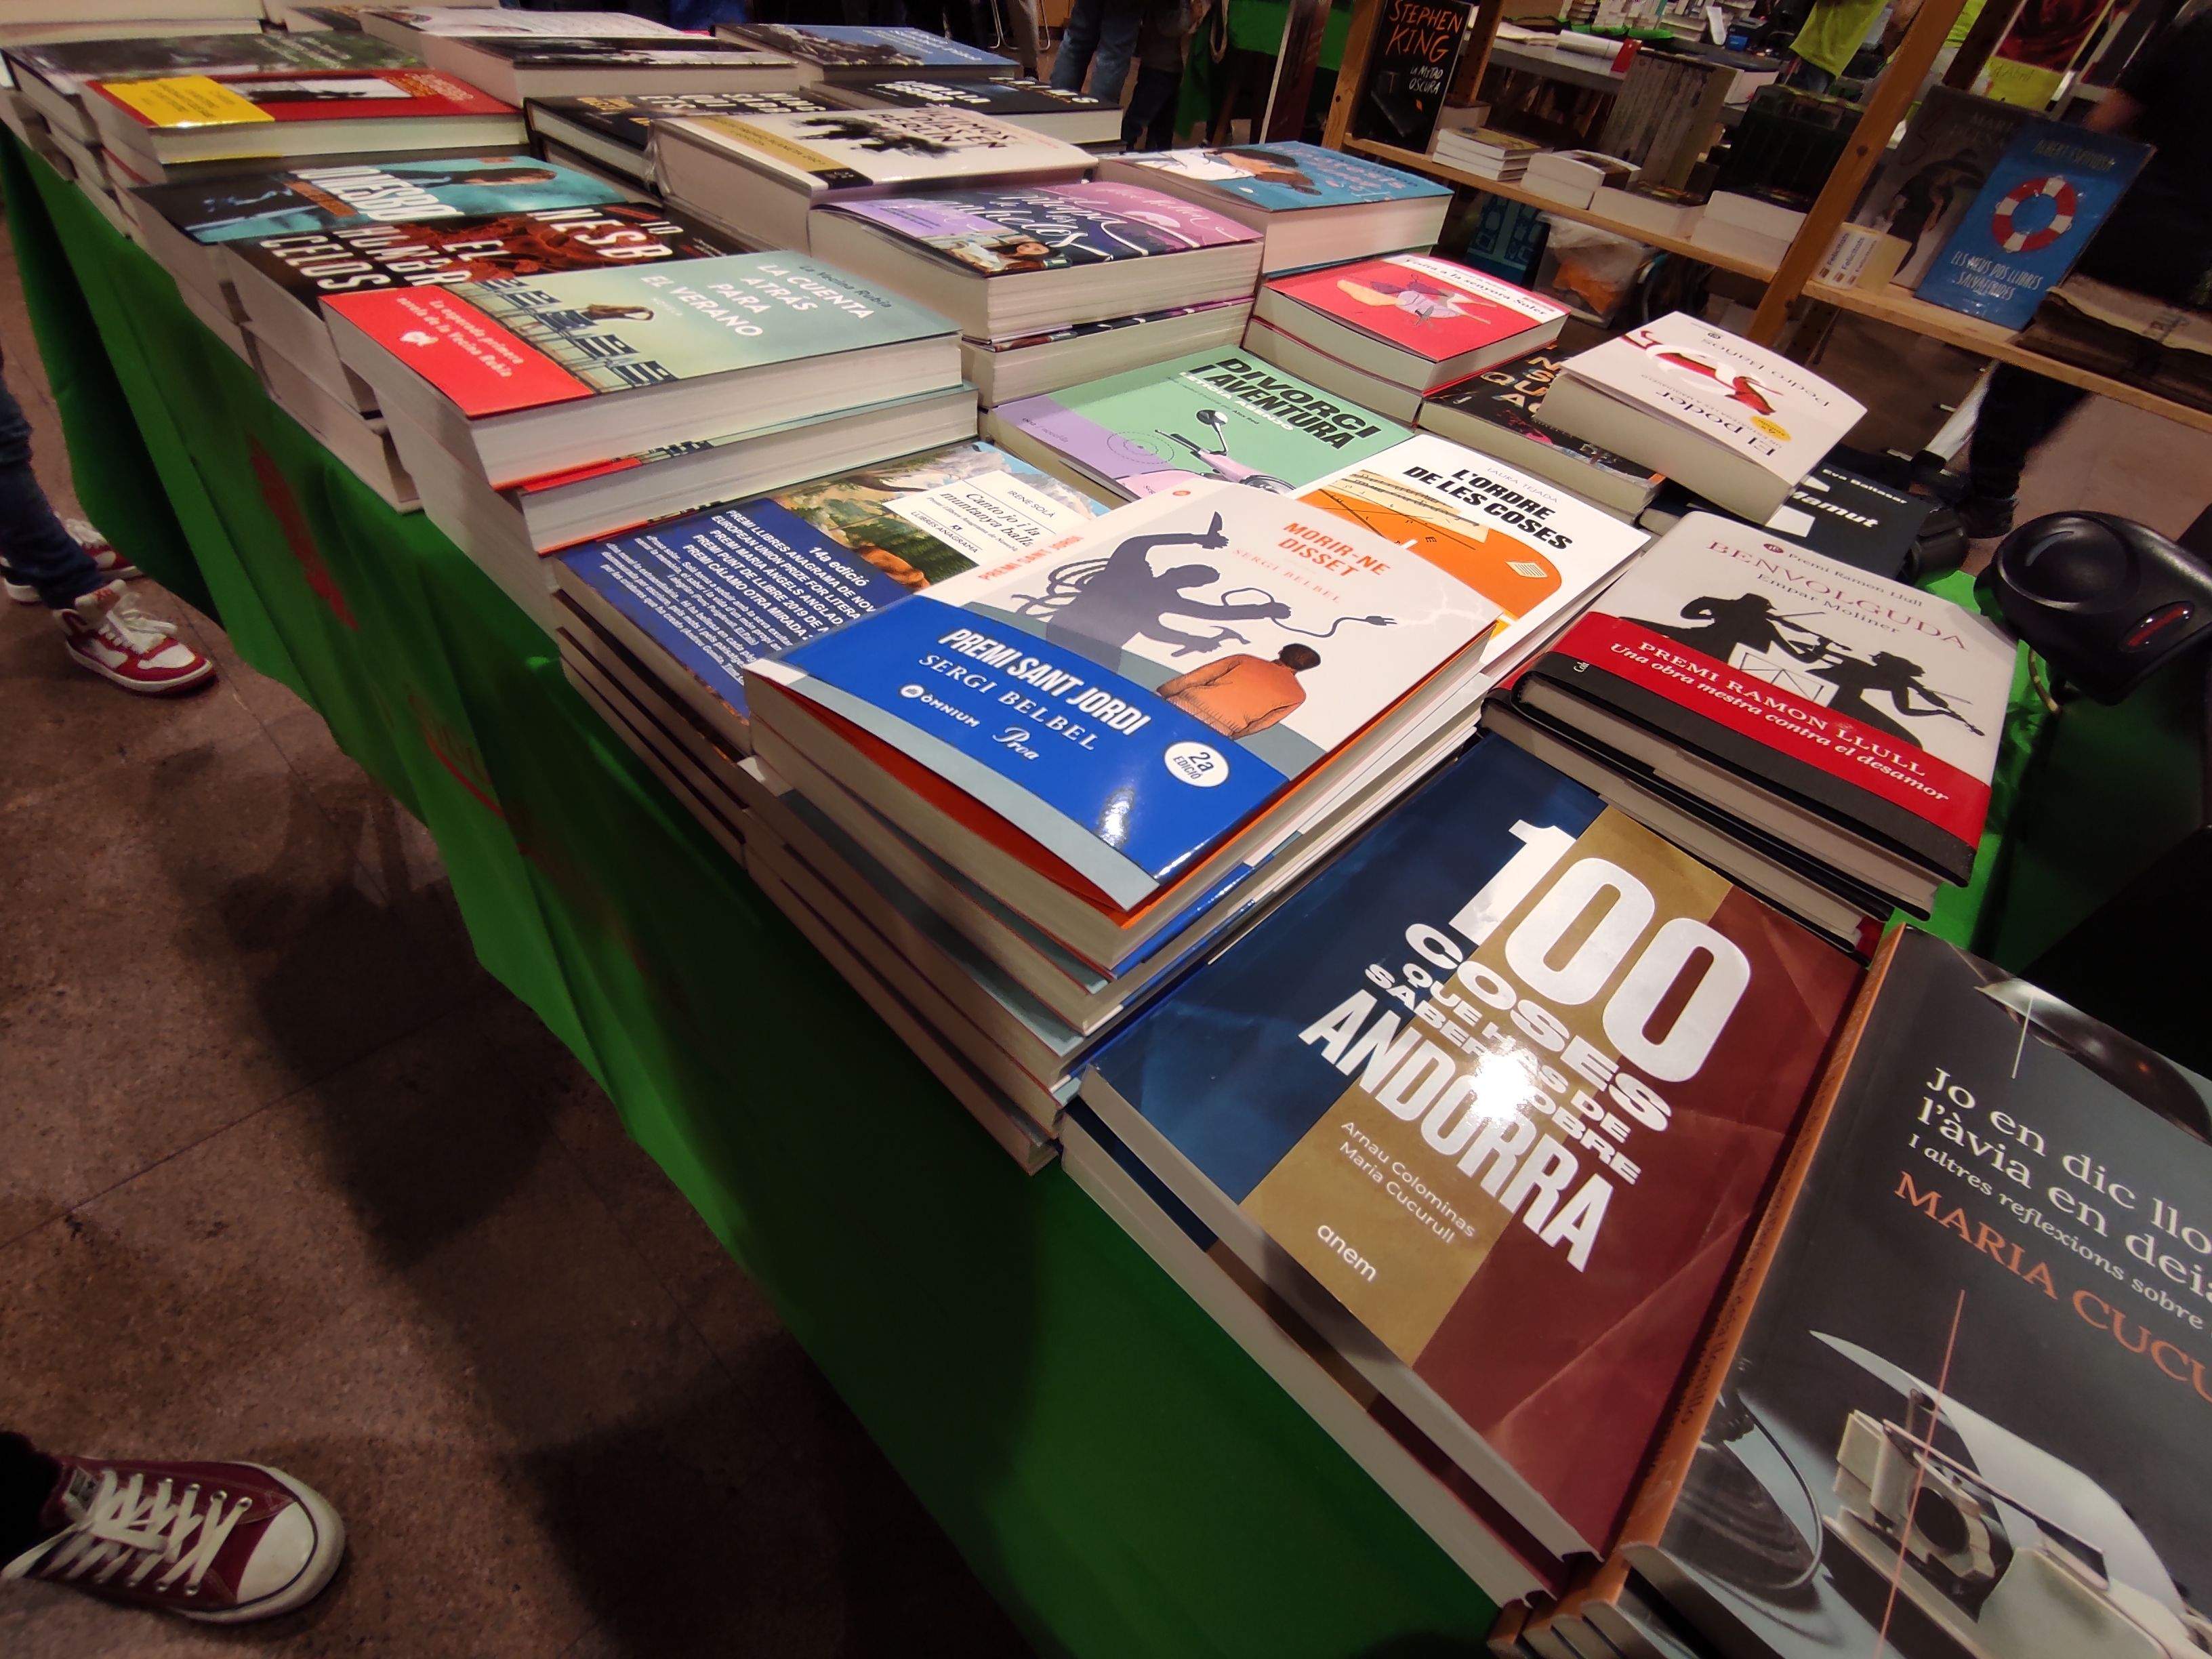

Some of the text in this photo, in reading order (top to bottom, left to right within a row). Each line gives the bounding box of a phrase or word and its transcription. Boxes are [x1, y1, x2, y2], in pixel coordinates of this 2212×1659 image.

[1385, 24, 1450, 62] KING
[1389, 0, 1463, 33] STEPHEN
[1409, 78, 1441, 95] OSCURA
[640, 275, 675, 289] EL
[670, 286, 764, 337] VERANO
[708, 283, 772, 314] PARA
[740, 276, 819, 312] ATRÁS
[757, 264, 876, 321] LA CUENTA
[854, 289, 893, 309] Rubia
[1464, 279, 1511, 301] senyora
[1513, 298, 1548, 316] Soler
[1179, 371, 1233, 400] LETICIA
[1233, 400, 1295, 431] ASENJO
[1189, 364, 1217, 374] I
[1204, 374, 1356, 450] AVENTURA
[1216, 358, 1382, 439] DIVORCI
[1656, 391, 1743, 434] Poder
[1007, 490, 1055, 518] IRENE SOLÀ
[1450, 468, 1557, 521] L'ORDRE
[1486, 466, 1559, 504] LAURA TEJADA
[1822, 469, 1847, 480] Eva
[910, 510, 979, 554] LLIBRES ANAGRAMA
[940, 493, 1035, 548] muntanya balla
[966, 493, 1004, 516] Canto
[1024, 525, 1042, 537] la
[1402, 466, 1574, 550] DE LES COSES
[709, 529, 739, 549] PREMI
[736, 547, 768, 573] MARIA
[711, 515, 760, 550] EUROPEAN
[754, 544, 785, 569] UNION
[780, 562, 806, 583] PRIZE
[805, 579, 828, 596] FOR
[725, 510, 856, 598] PREMI LLIBRES ANAGRAMA DE
[808, 546, 871, 587] 14a edició
[979, 563, 1019, 580] PREMI
[1233, 547, 1340, 602] SERGI BELBEL
[1278, 537, 1359, 577] DISSET
[1283, 523, 1391, 576] MORIR-NE
[682, 544, 714, 567] PREMI
[709, 562, 748, 591] CÁLAMO
[744, 587, 773, 610] OTRA
[767, 606, 808, 639] MIRADA
[693, 533, 722, 554] PREMI
[718, 552, 746, 573] PUNT
[740, 567, 758, 581] DE
[752, 577, 789, 604] LLIBRE
[782, 598, 809, 617] 2019
[805, 614, 824, 629] DE
[1706, 541, 1969, 652] BENVOLGUDA
[1756, 573, 1901, 634] Empar Moliner
[1788, 552, 1923, 608] Premi Ramon Llull
[918, 654, 1096, 751] SERGI BELBEL
[938, 628, 1152, 737] PREMI SANT JORDI
[1637, 641, 1927, 777] PREMI RAMON LLULL
[991, 726, 1041, 761] Proa
[1610, 642, 1952, 802] Una obra mestra contra el desamor
[1172, 756, 1203, 781] EDICIÓ
[1188, 751, 1216, 773] 2a
[1448, 819, 1751, 1083] 100
[1402, 963, 1483, 1027] QUE
[1570, 1088, 1632, 1144] DE
[1405, 922, 1673, 1132] COSES
[1298, 989, 1614, 1273] ANDORRA
[1515, 1074, 1643, 1185] OBRE
[1926, 1067, 1976, 1109] Jo
[1990, 1110, 2047, 1158] en
[2062, 1153, 2136, 1210] dic
[1339, 1142, 1457, 1246] Maria Cucurull
[1340, 1121, 1477, 1238] Arnau Colominas
[1917, 1096, 2032, 1190] l'àvia
[2047, 1186, 2109, 1237] en
[1315, 1223, 1378, 1283] anem
[1894, 1171, 2059, 1300] MARIA
[1923, 1145, 1993, 1196] altres
[1999, 1191, 2127, 1281] reflexions
[2130, 1277, 2205, 1331] sobre
